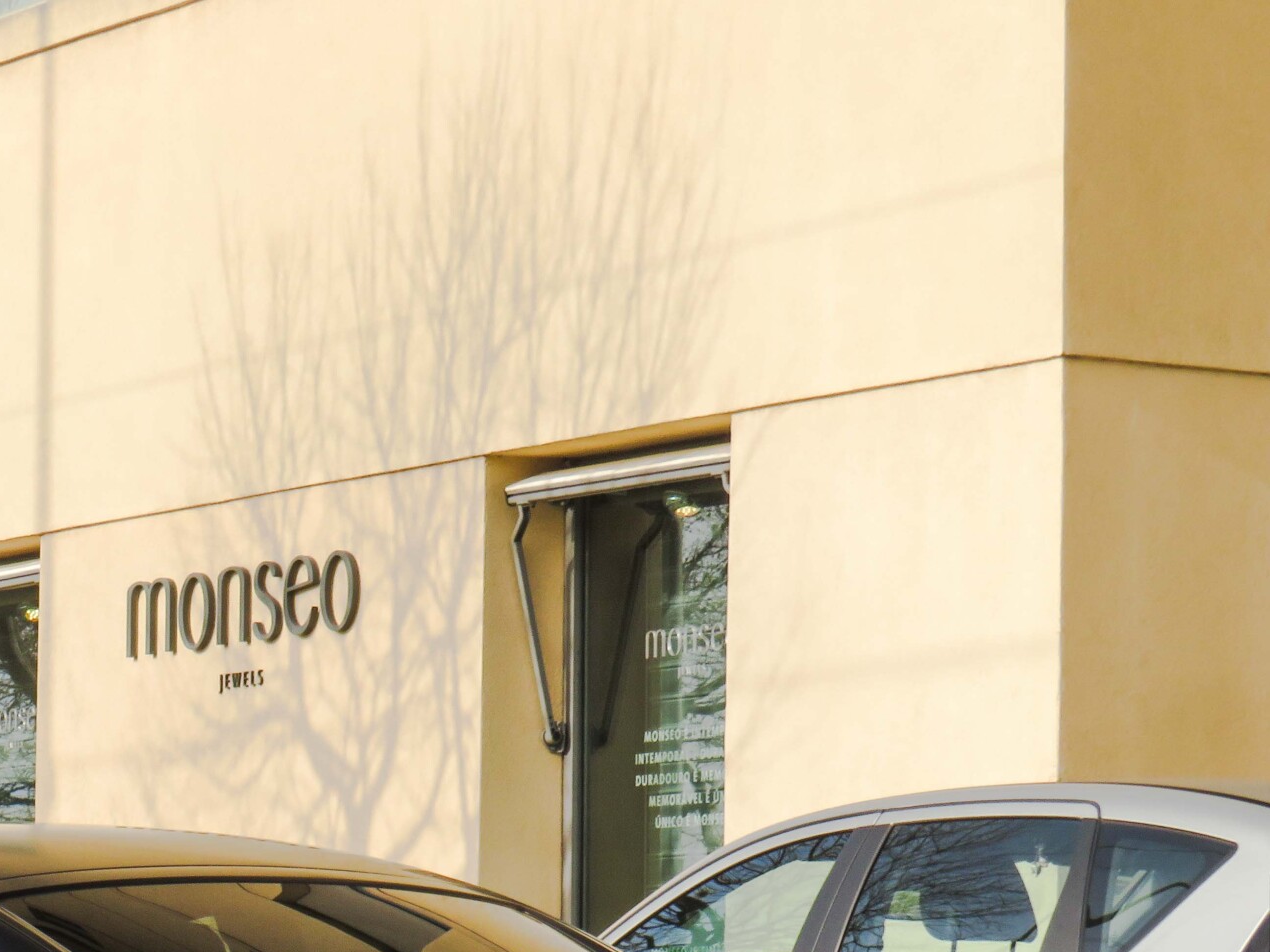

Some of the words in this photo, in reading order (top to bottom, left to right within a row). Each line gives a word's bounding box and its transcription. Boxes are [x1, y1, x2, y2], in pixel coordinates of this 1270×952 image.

[126, 550, 362, 661] monseo
[645, 623, 726, 659] monse
[219, 669, 264, 694] JEWELS
[635, 771, 690, 787] DURADOURO
[655, 814, 682, 829] ÚNICO
